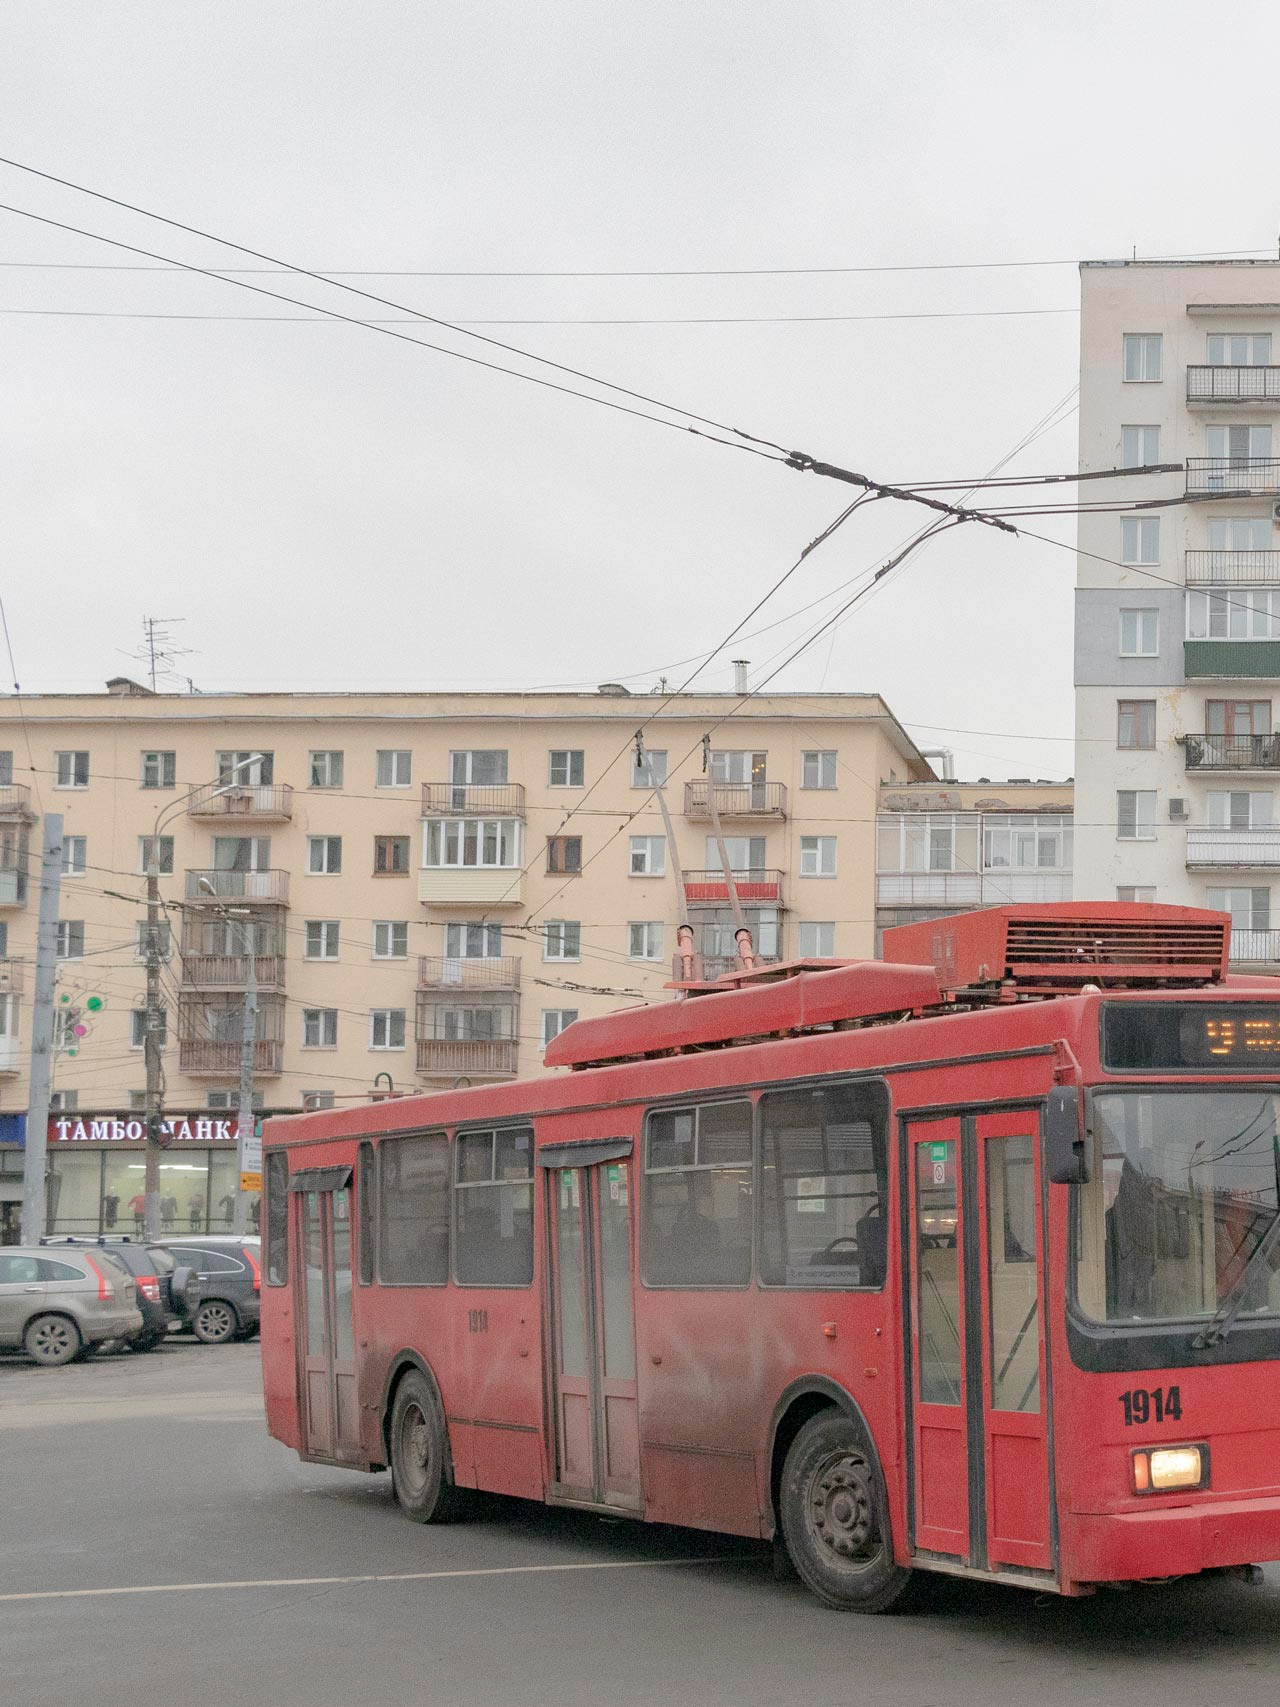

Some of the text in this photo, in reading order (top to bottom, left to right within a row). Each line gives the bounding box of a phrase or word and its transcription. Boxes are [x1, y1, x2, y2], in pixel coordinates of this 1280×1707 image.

[57, 1121, 239, 1140] ТАМБОЧАНК
[468, 1310, 489, 1333] 1914
[1118, 1386, 1183, 1427] 1914
